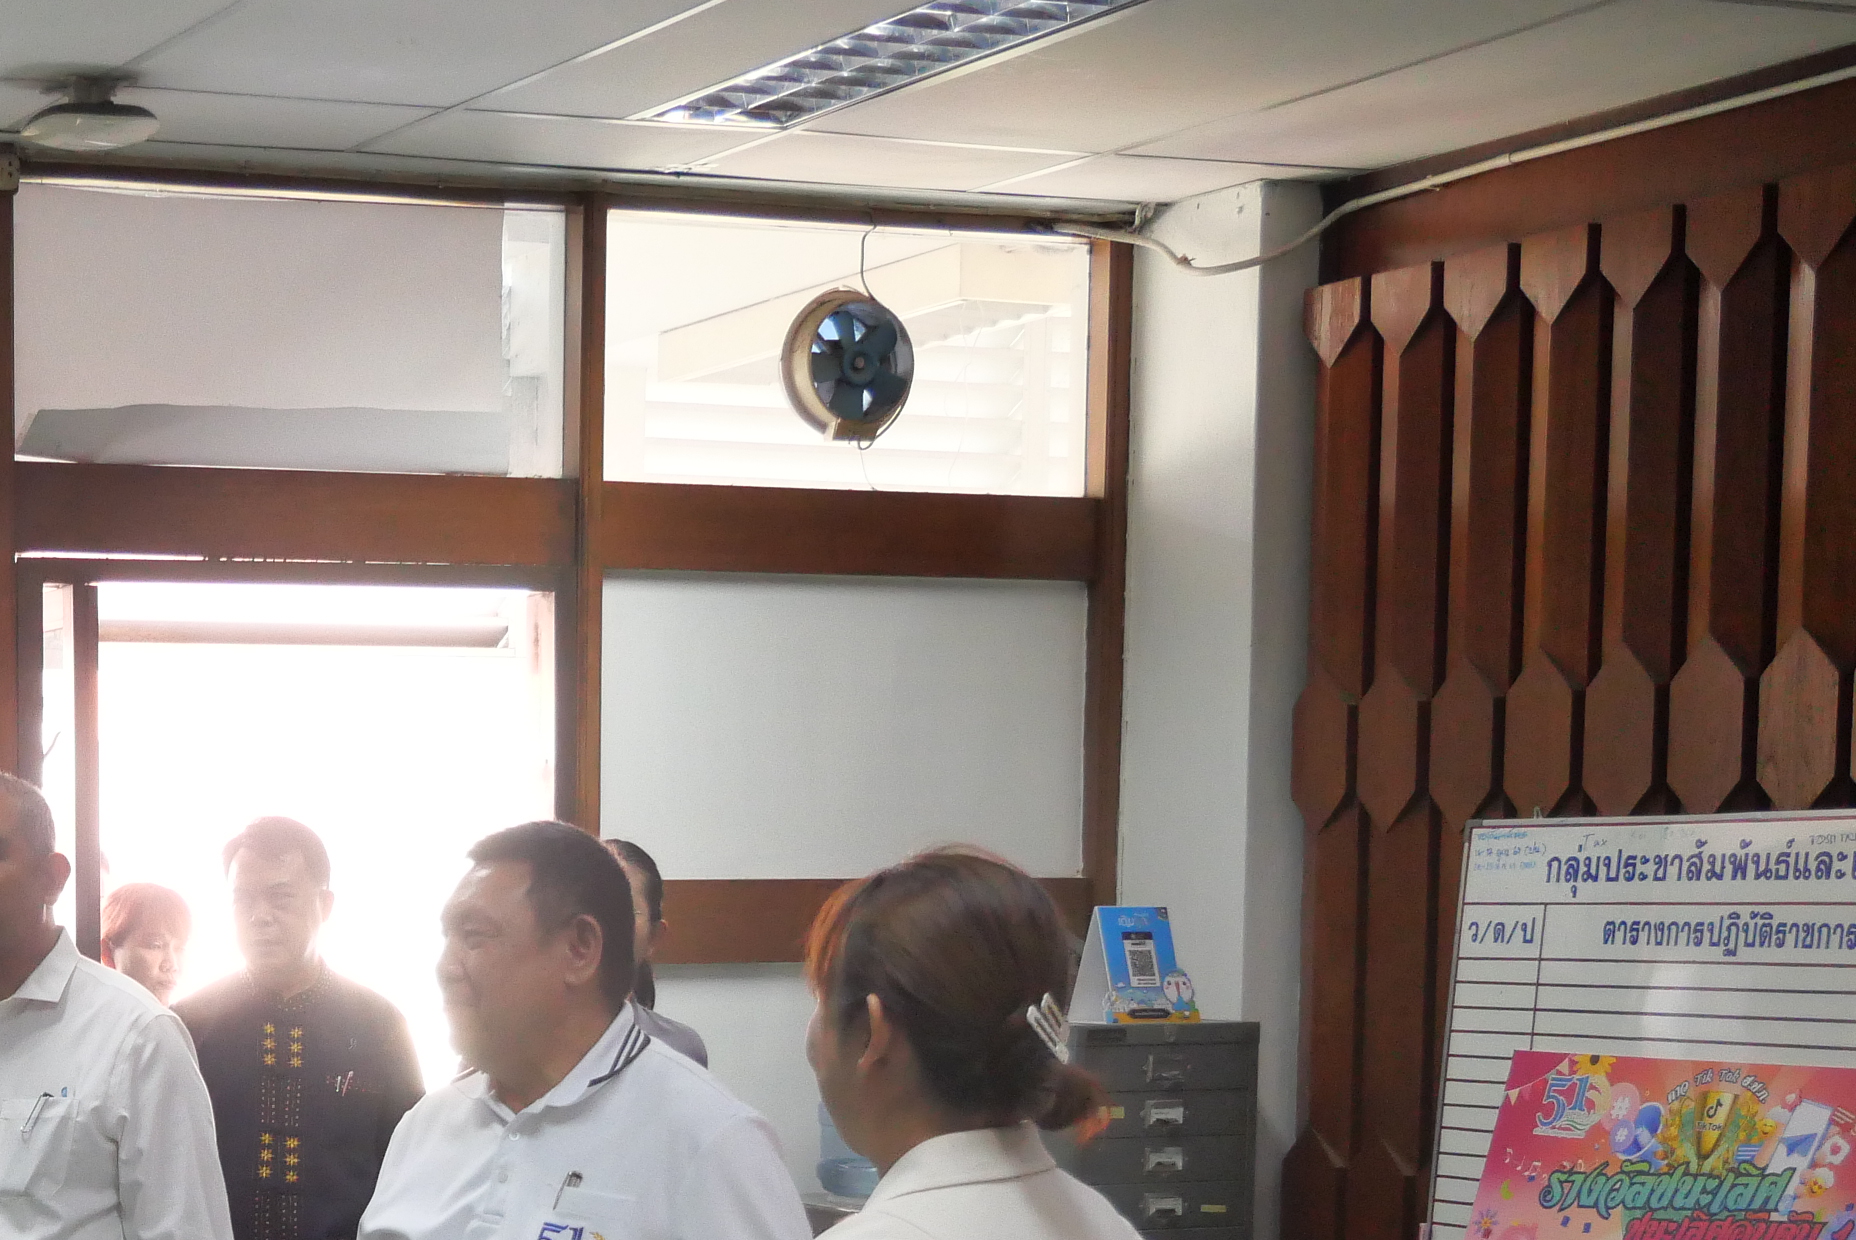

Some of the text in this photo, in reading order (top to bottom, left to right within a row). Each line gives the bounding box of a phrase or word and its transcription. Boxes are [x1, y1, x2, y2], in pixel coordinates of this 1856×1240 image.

[1468, 917, 1536, 945] ว/ด/ป
[1694, 1067, 1714, 1087] Tik
[1718, 1067, 1741, 1084] Tok
[1536, 1075, 1590, 1128] 51
[1539, 1159, 1796, 1219] รางวัลชนะเลิศ
